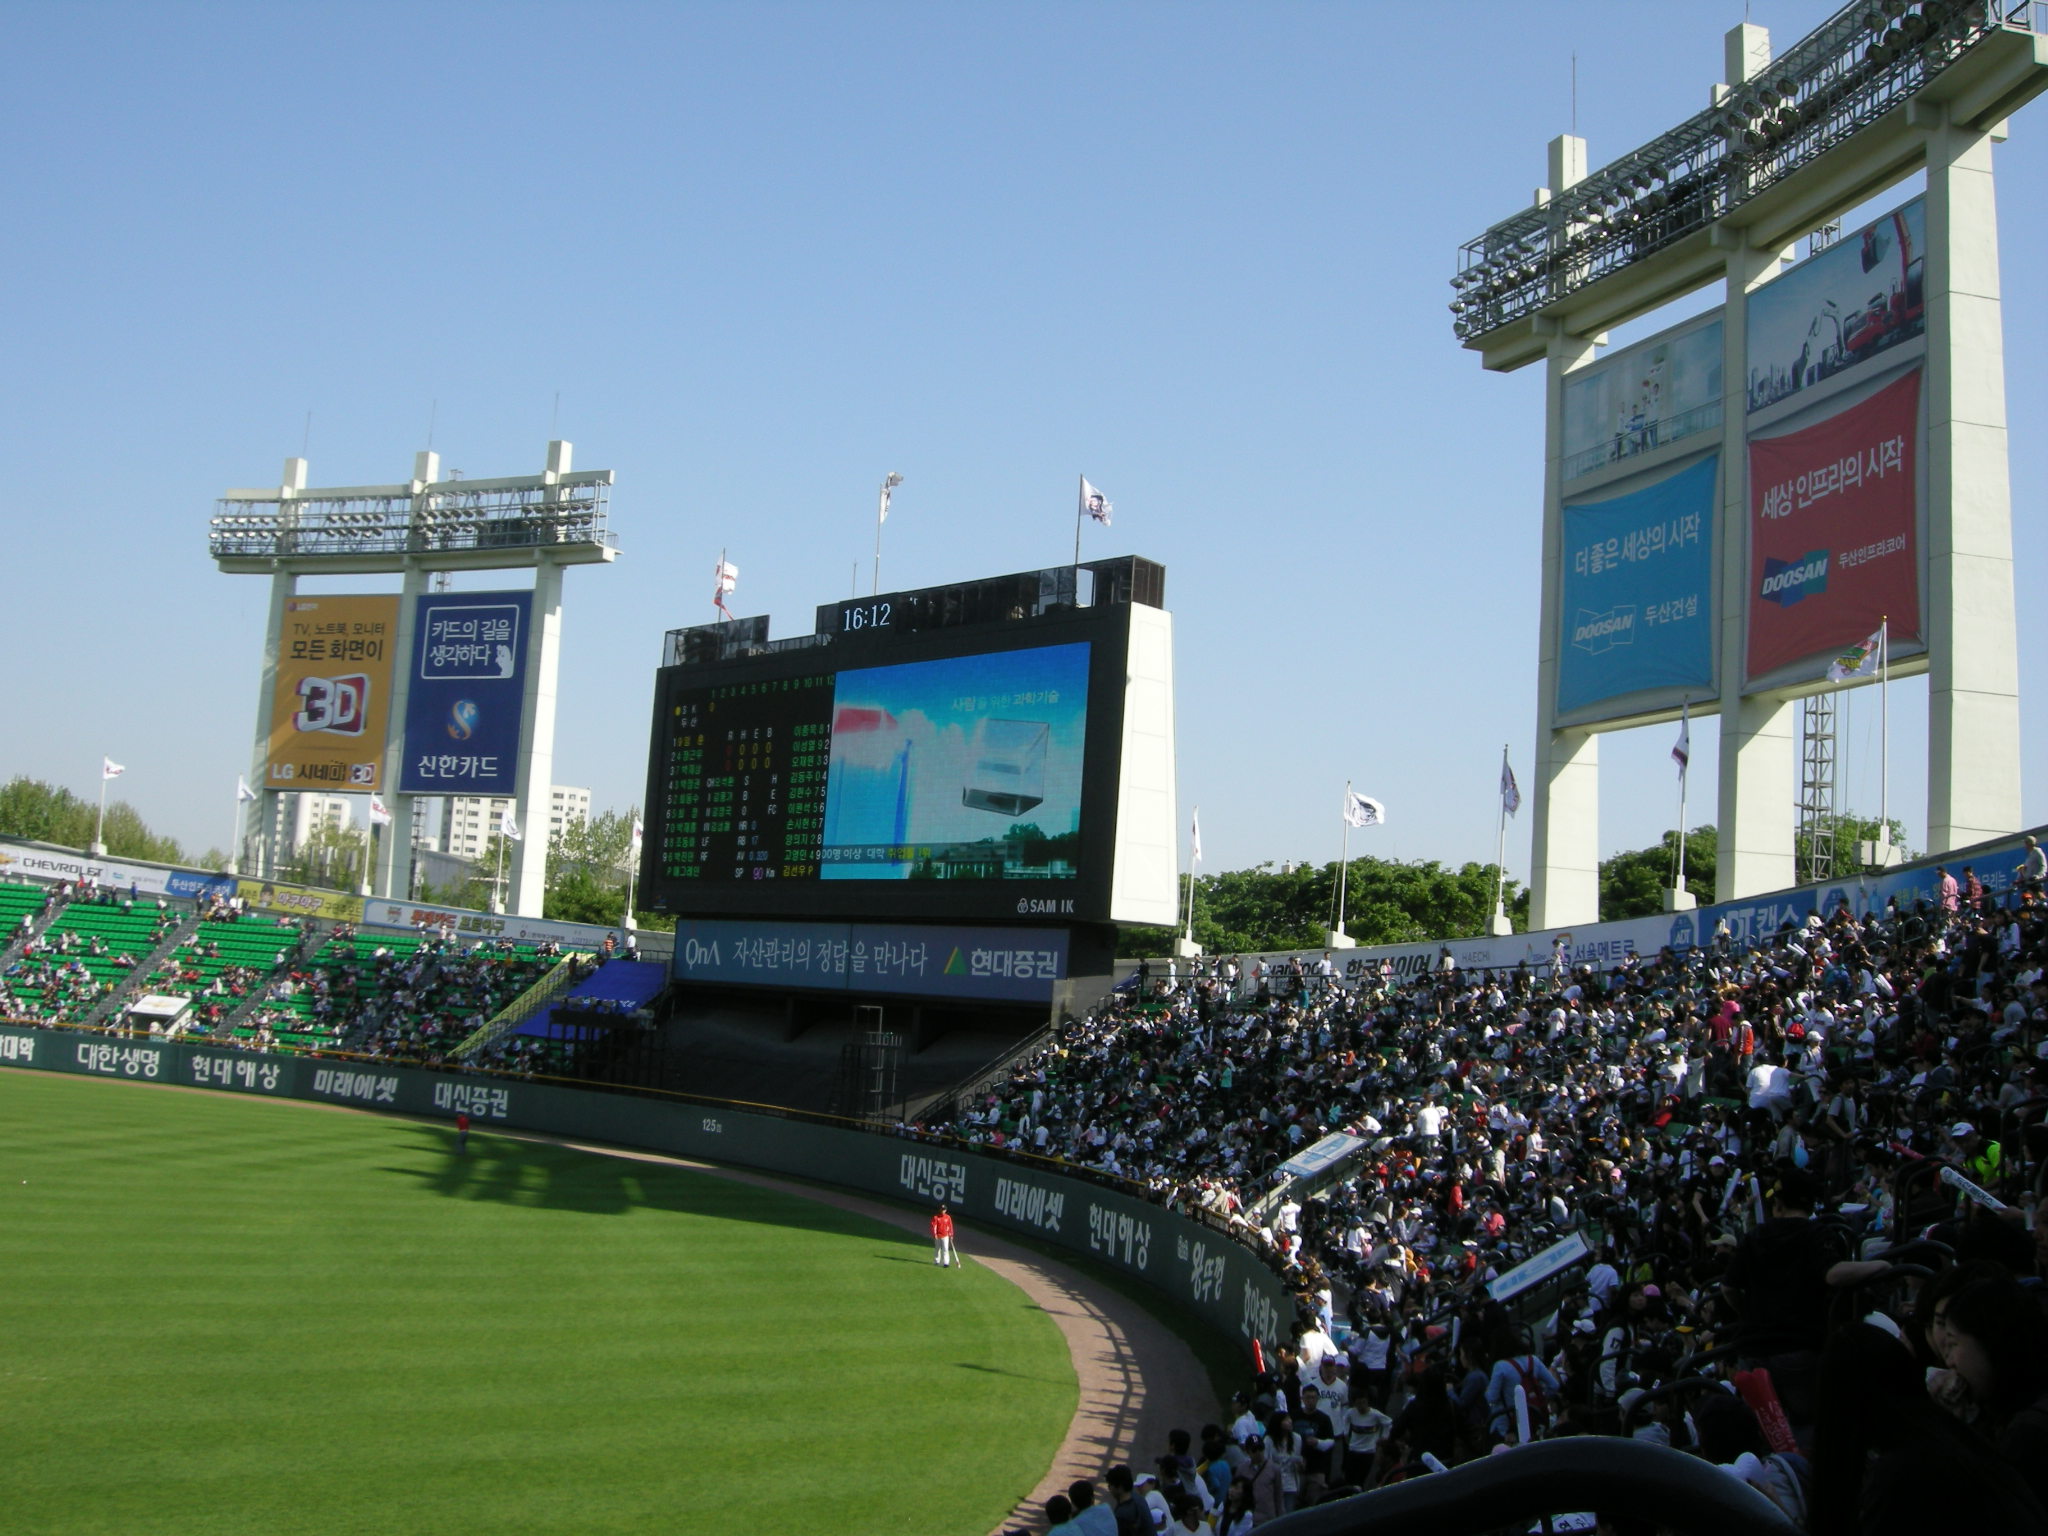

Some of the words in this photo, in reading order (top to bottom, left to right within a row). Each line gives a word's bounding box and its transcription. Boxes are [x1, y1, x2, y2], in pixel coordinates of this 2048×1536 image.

[1761, 483, 1794, 520] 세상
[1796, 451, 1862, 509] 인프라의
[1865, 435, 1904, 480] 시작
[1575, 549, 1589, 576] 더
[1590, 537, 1619, 576] 좋은
[1623, 522, 1666, 562] 세상의
[1668, 511, 1701, 546] 시작
[1838, 533, 1906, 569] 두산인프라코어
[1761, 558, 1828, 594] DOOSAN
[844, 603, 890, 631] 16:12
[1644, 594, 1698, 627] 두산건설
[352, 622, 385, 635] 모니터
[432, 620, 478, 642] 카드의
[480, 619, 510, 641] 길을
[1575, 612, 1634, 642] DOOSAN
[290, 640, 325, 660] 모든
[330, 639, 382, 661] 화면이
[430, 645, 490, 666] 생각하다
[295, 675, 357, 733] 3D
[272, 764, 294, 780] LG
[349, 764, 376, 784] 3D
[418, 755, 498, 778] 신한카드
[768, 804, 777, 814] FC
[22, 857, 104, 878] CHEVROLET
[843, 848, 862, 860] 이상
[278, 891, 324, 912] 마구마구
[1030, 900, 1056, 914] SAM
[1061, 899, 1074, 914] IK
[1675, 928, 1692, 946] ADT
[1756, 904, 1799, 945] 캡스
[733, 938, 812, 970] 자산관리의
[816, 940, 870, 972] 정답을
[874, 941, 928, 976] 만나다
[971, 948, 1058, 978] 현대증권
[1462, 950, 1490, 962] HAECHI
[1574, 939, 1634, 962] 서울메트로
[77, 1043, 160, 1077] 대한생명
[192, 1054, 280, 1090] 현대해상
[313, 1070, 398, 1102] 미래에셋
[434, 1082, 510, 1118] 대신증권
[900, 1154, 966, 1204] 대신증권
[995, 1178, 1064, 1232] 미래에셋
[1088, 1202, 1151, 1270] 현대해상
[1190, 1241, 1226, 1303] 왕뚜껑
